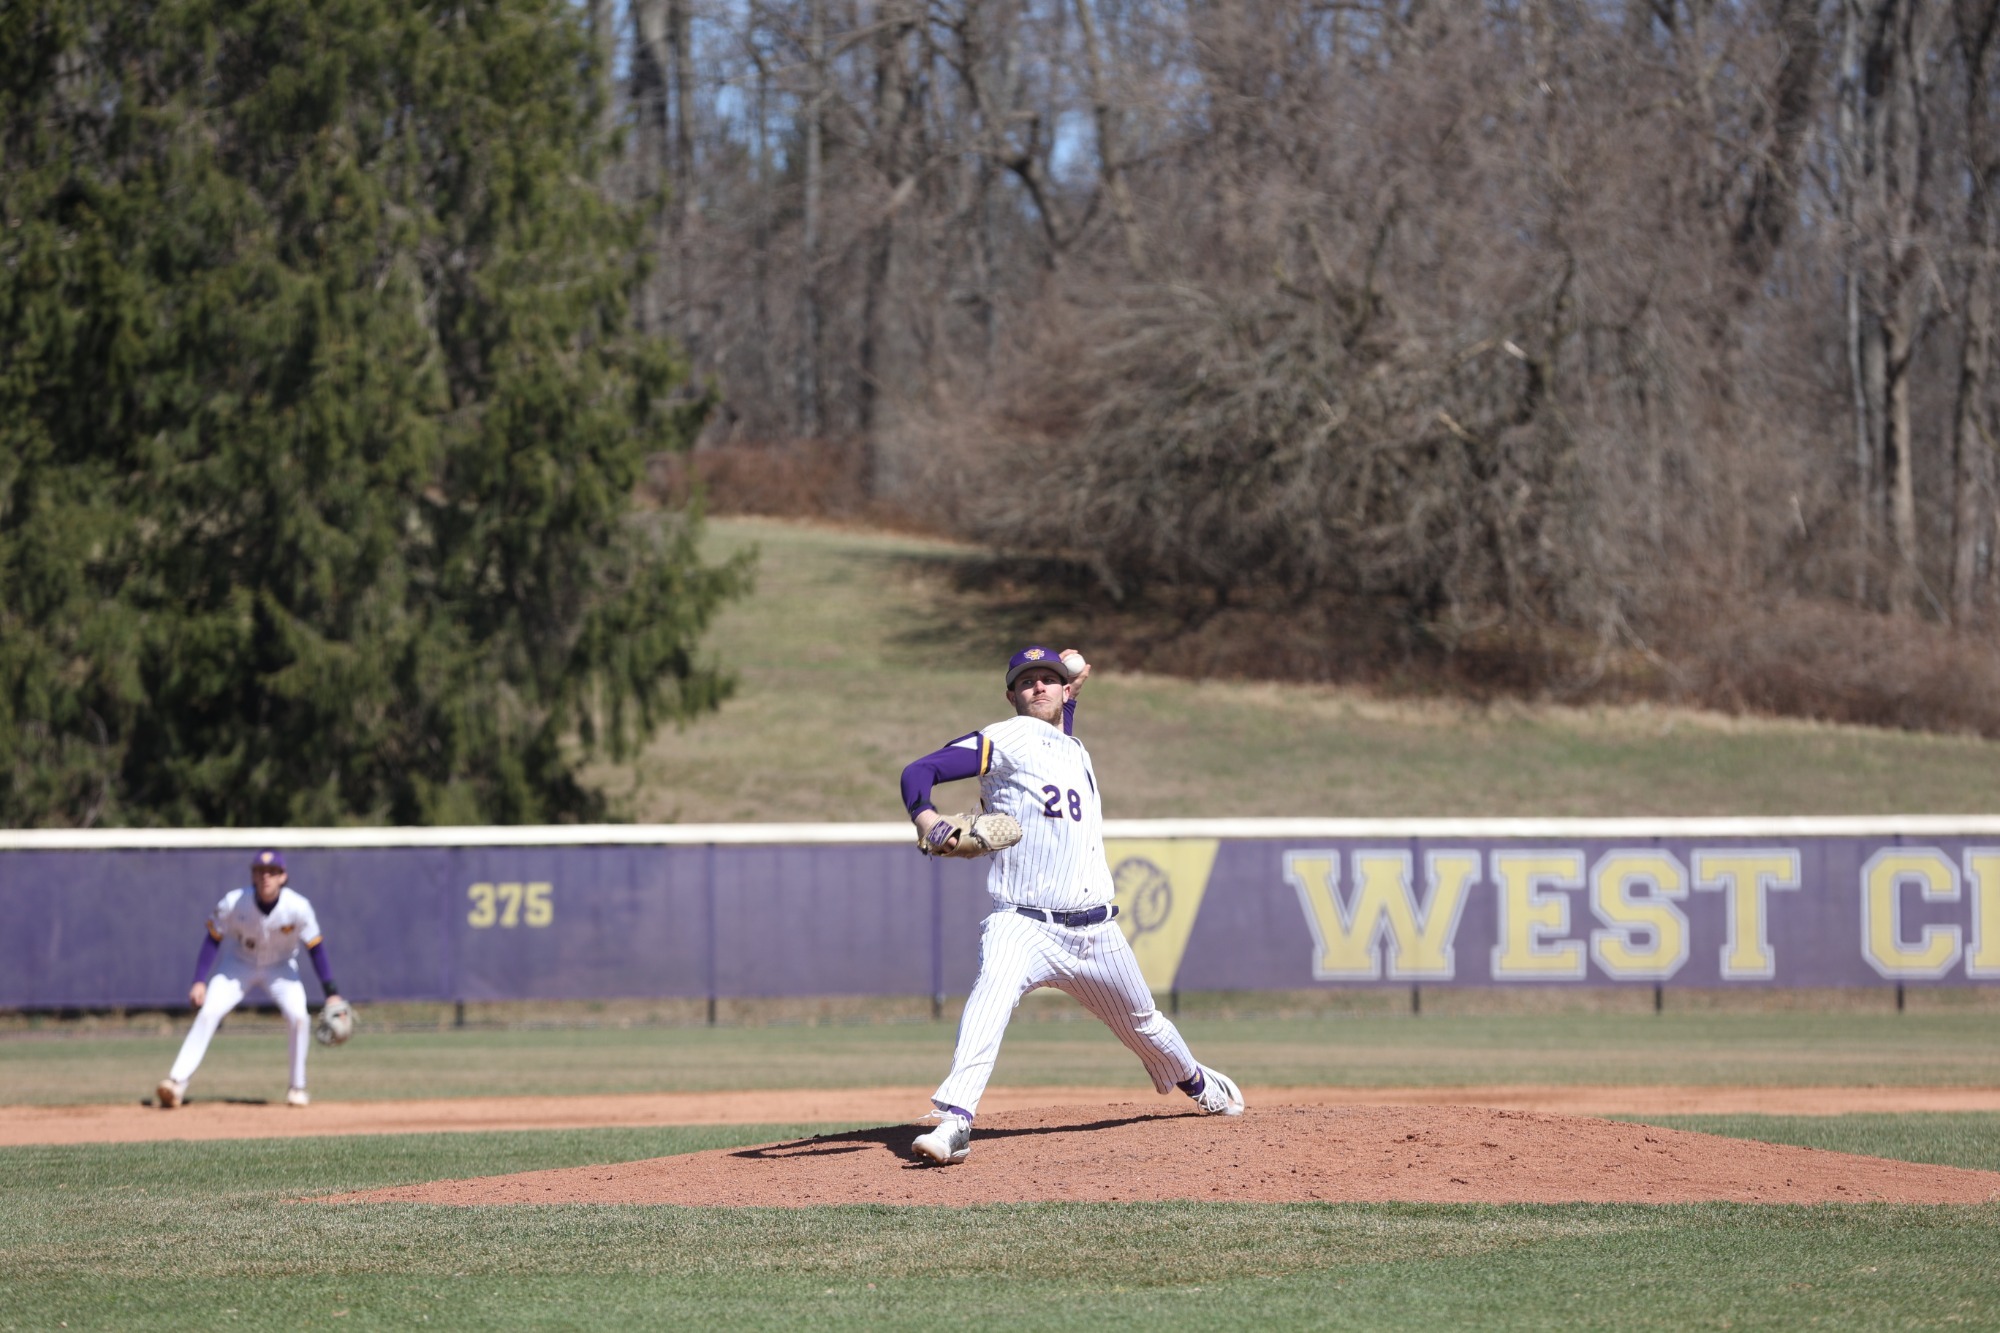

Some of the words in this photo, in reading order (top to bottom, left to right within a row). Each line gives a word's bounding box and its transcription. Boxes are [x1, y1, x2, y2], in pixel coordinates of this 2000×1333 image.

[1041, 784, 1082, 822] 28
[467, 881, 553, 929] 375
[1283, 847, 1801, 981] WEST
